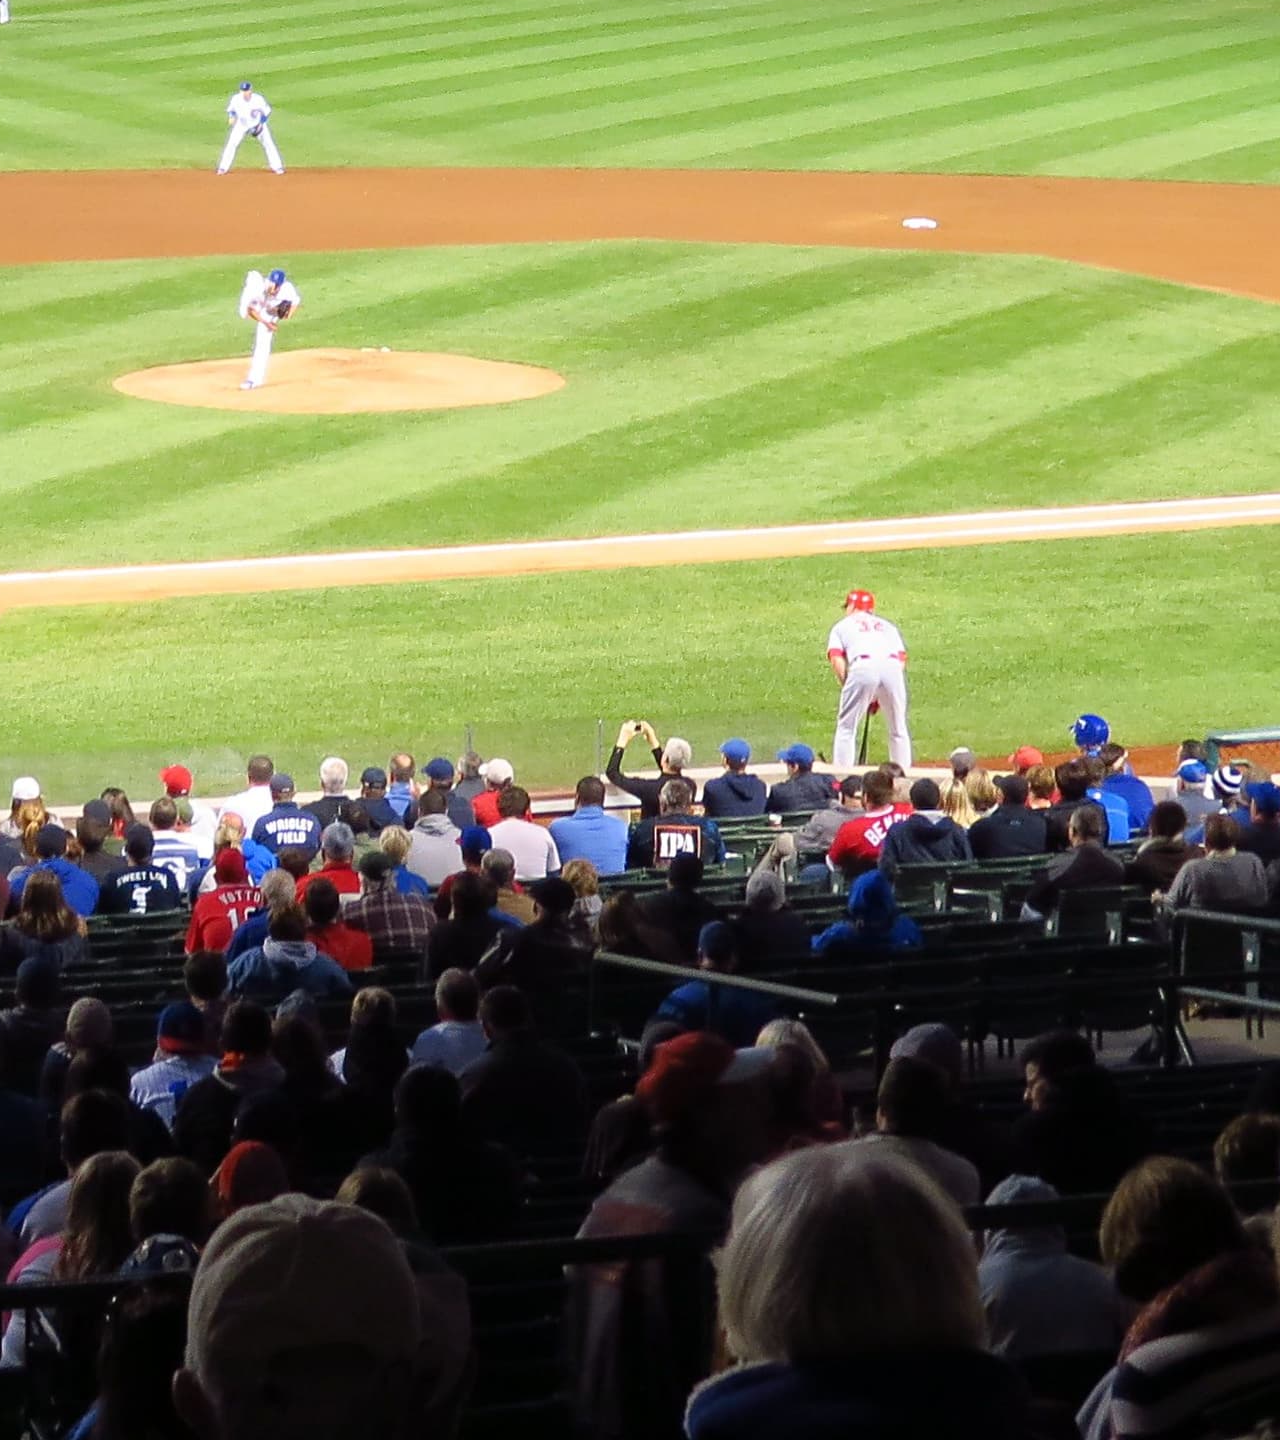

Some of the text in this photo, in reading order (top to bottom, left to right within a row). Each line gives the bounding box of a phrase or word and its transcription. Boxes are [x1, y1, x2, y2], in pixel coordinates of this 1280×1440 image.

[265, 817, 314, 832] WRIGLEY
[276, 832, 307, 844] FIELD
[659, 833, 695, 859] IPA
[219, 890, 261, 905] VOTTO
